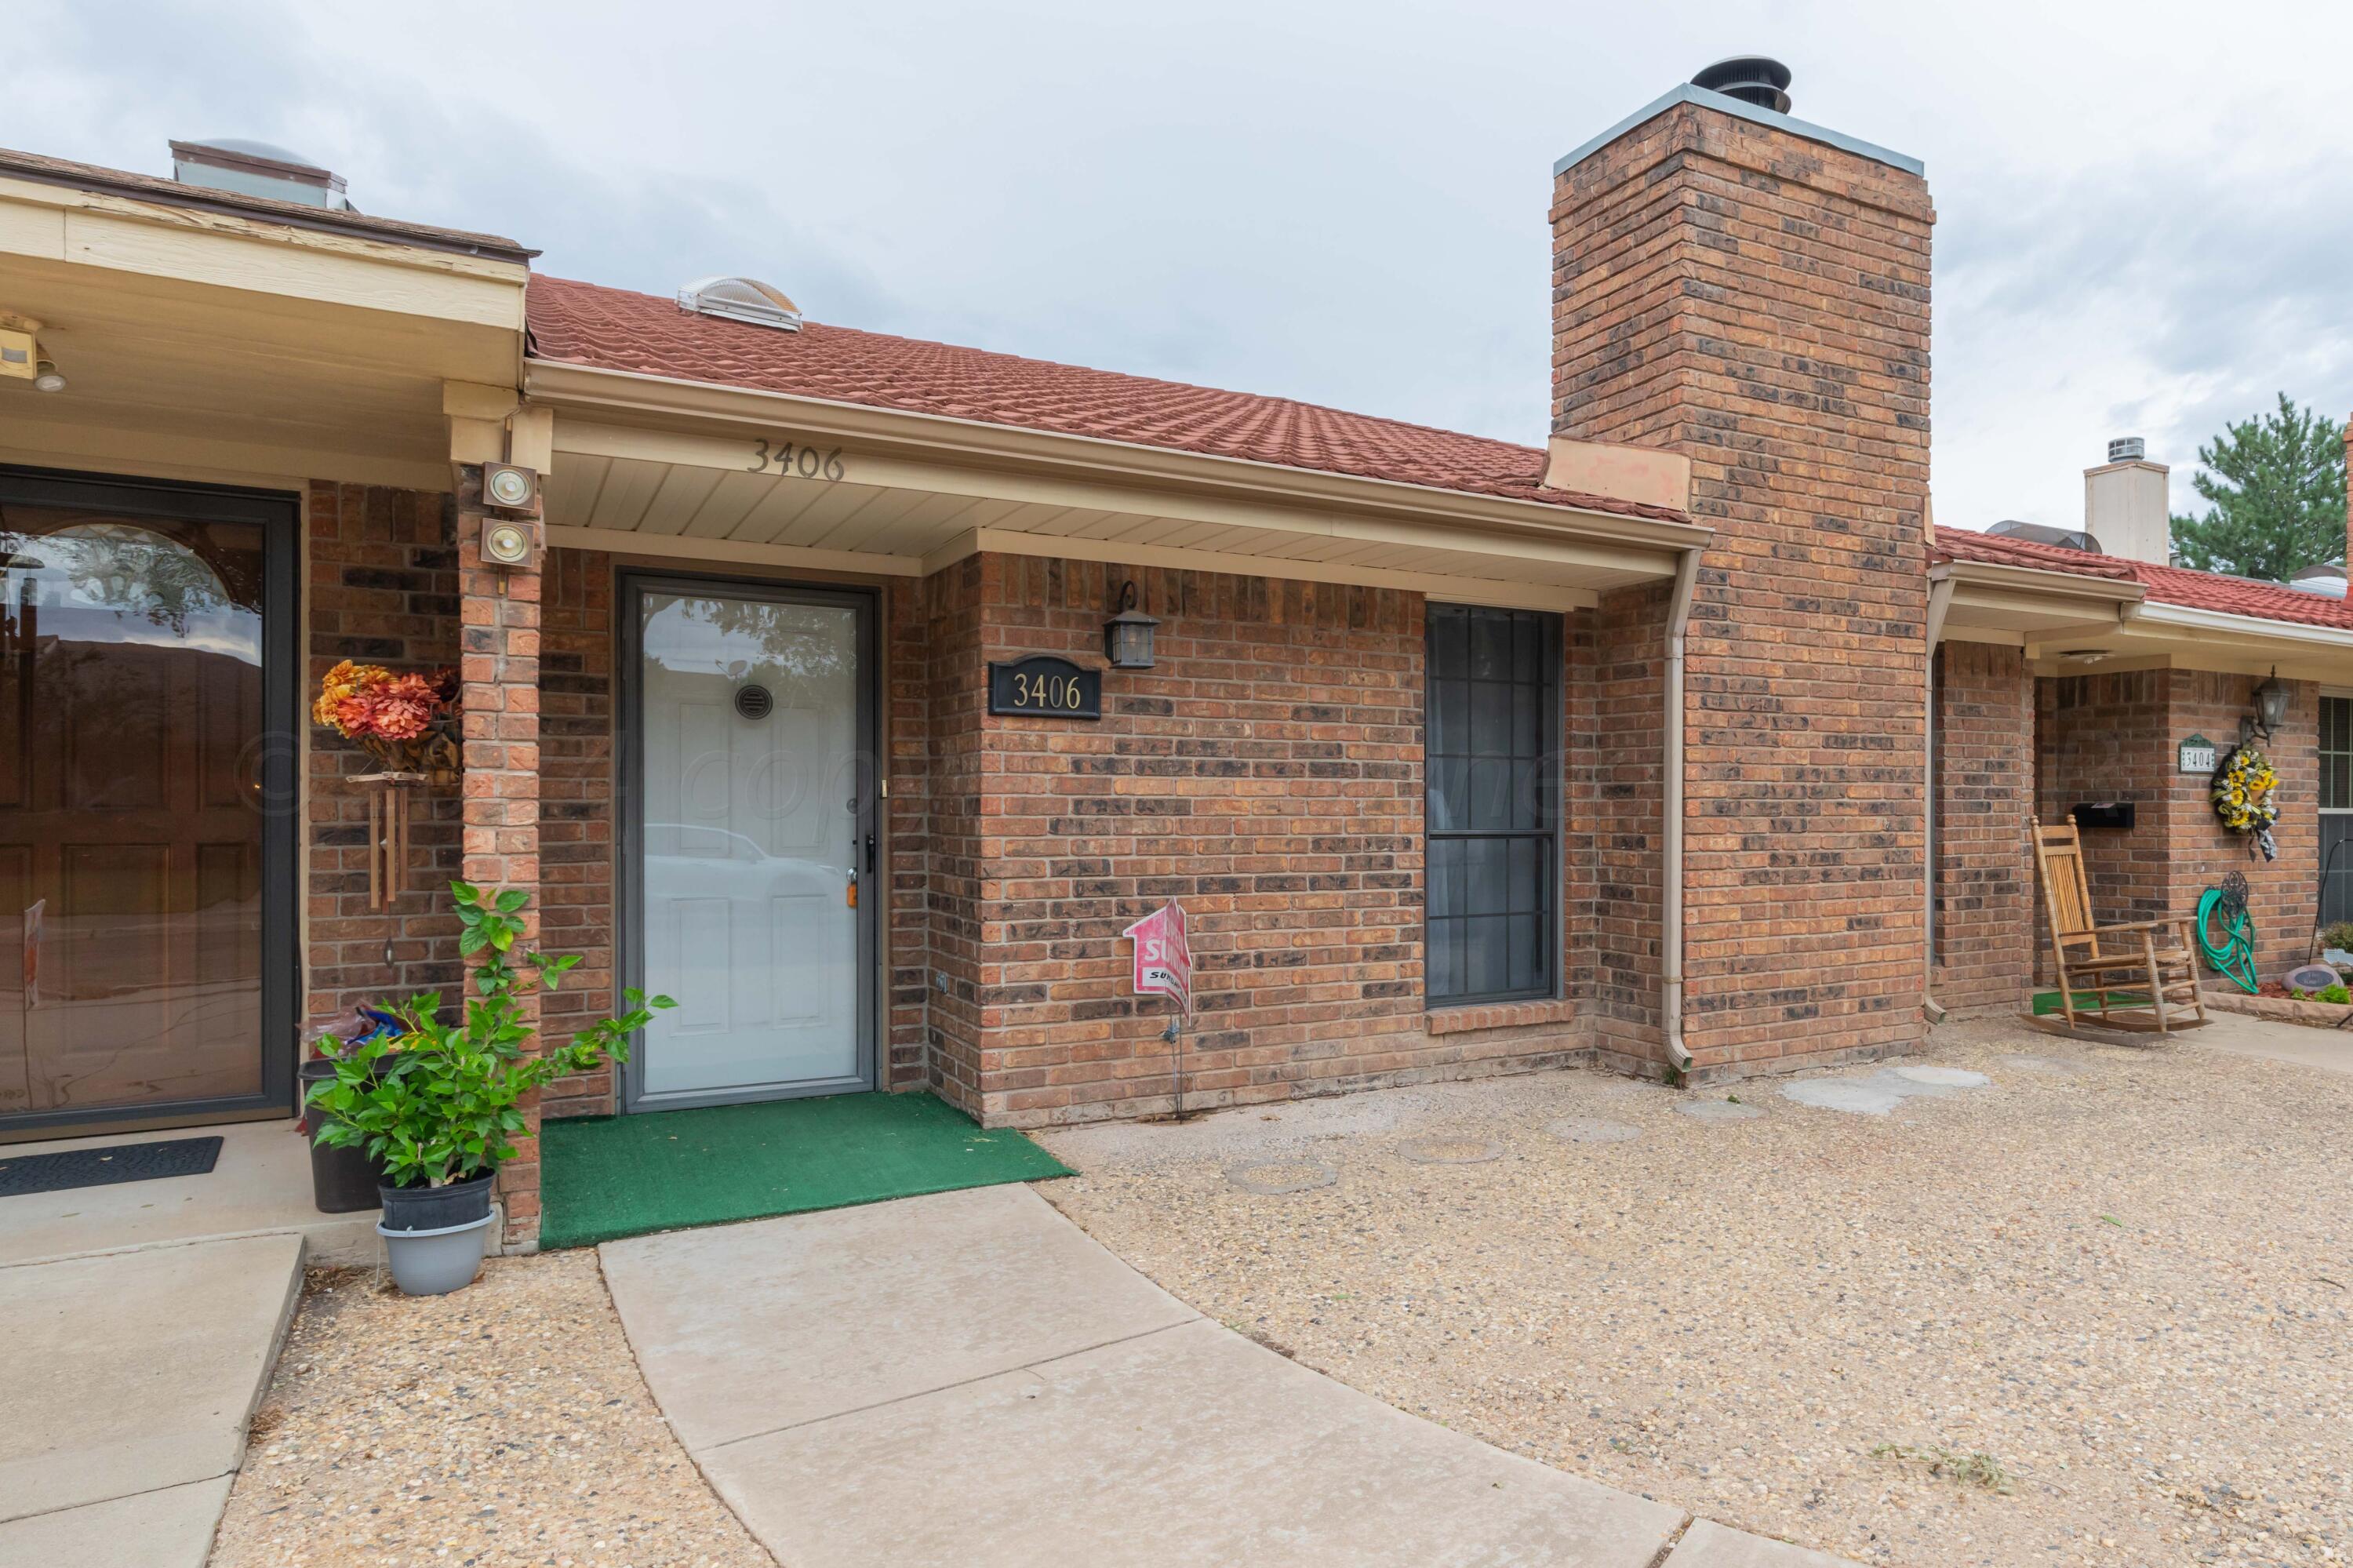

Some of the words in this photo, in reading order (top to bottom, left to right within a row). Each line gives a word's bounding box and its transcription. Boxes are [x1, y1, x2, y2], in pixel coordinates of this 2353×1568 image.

[747, 438, 845, 482] 3406
[1013, 673, 1081, 709] 3406
[2185, 751, 2210, 767] 3404
